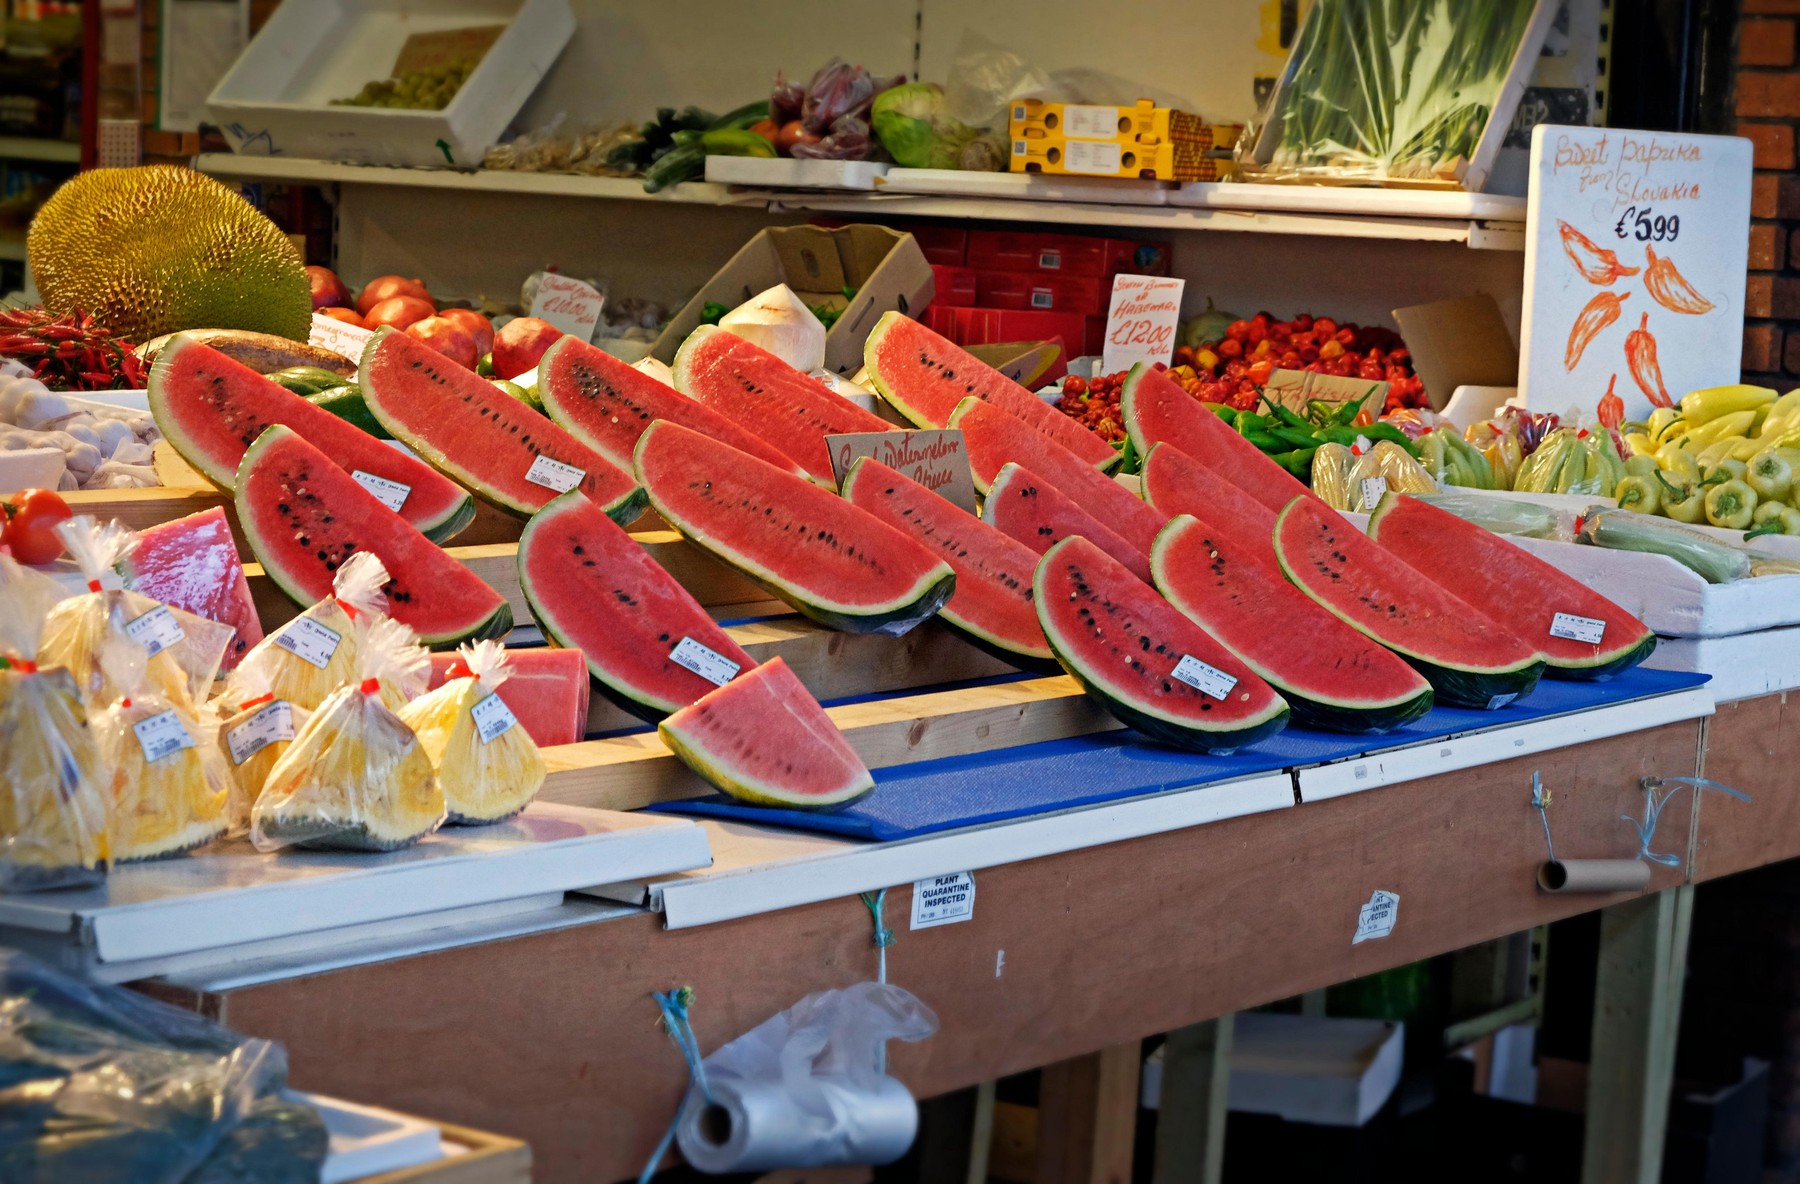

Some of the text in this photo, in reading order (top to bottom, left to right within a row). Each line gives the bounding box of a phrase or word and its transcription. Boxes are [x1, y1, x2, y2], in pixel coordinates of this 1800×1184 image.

[1554, 134, 1608, 175] Sweet
[935, 875, 959, 887] PLANT
[922, 883, 970, 899] QUARANTINE
[924, 893, 966, 908] INSPECTED
[1371, 910, 1389, 921] ECTED
